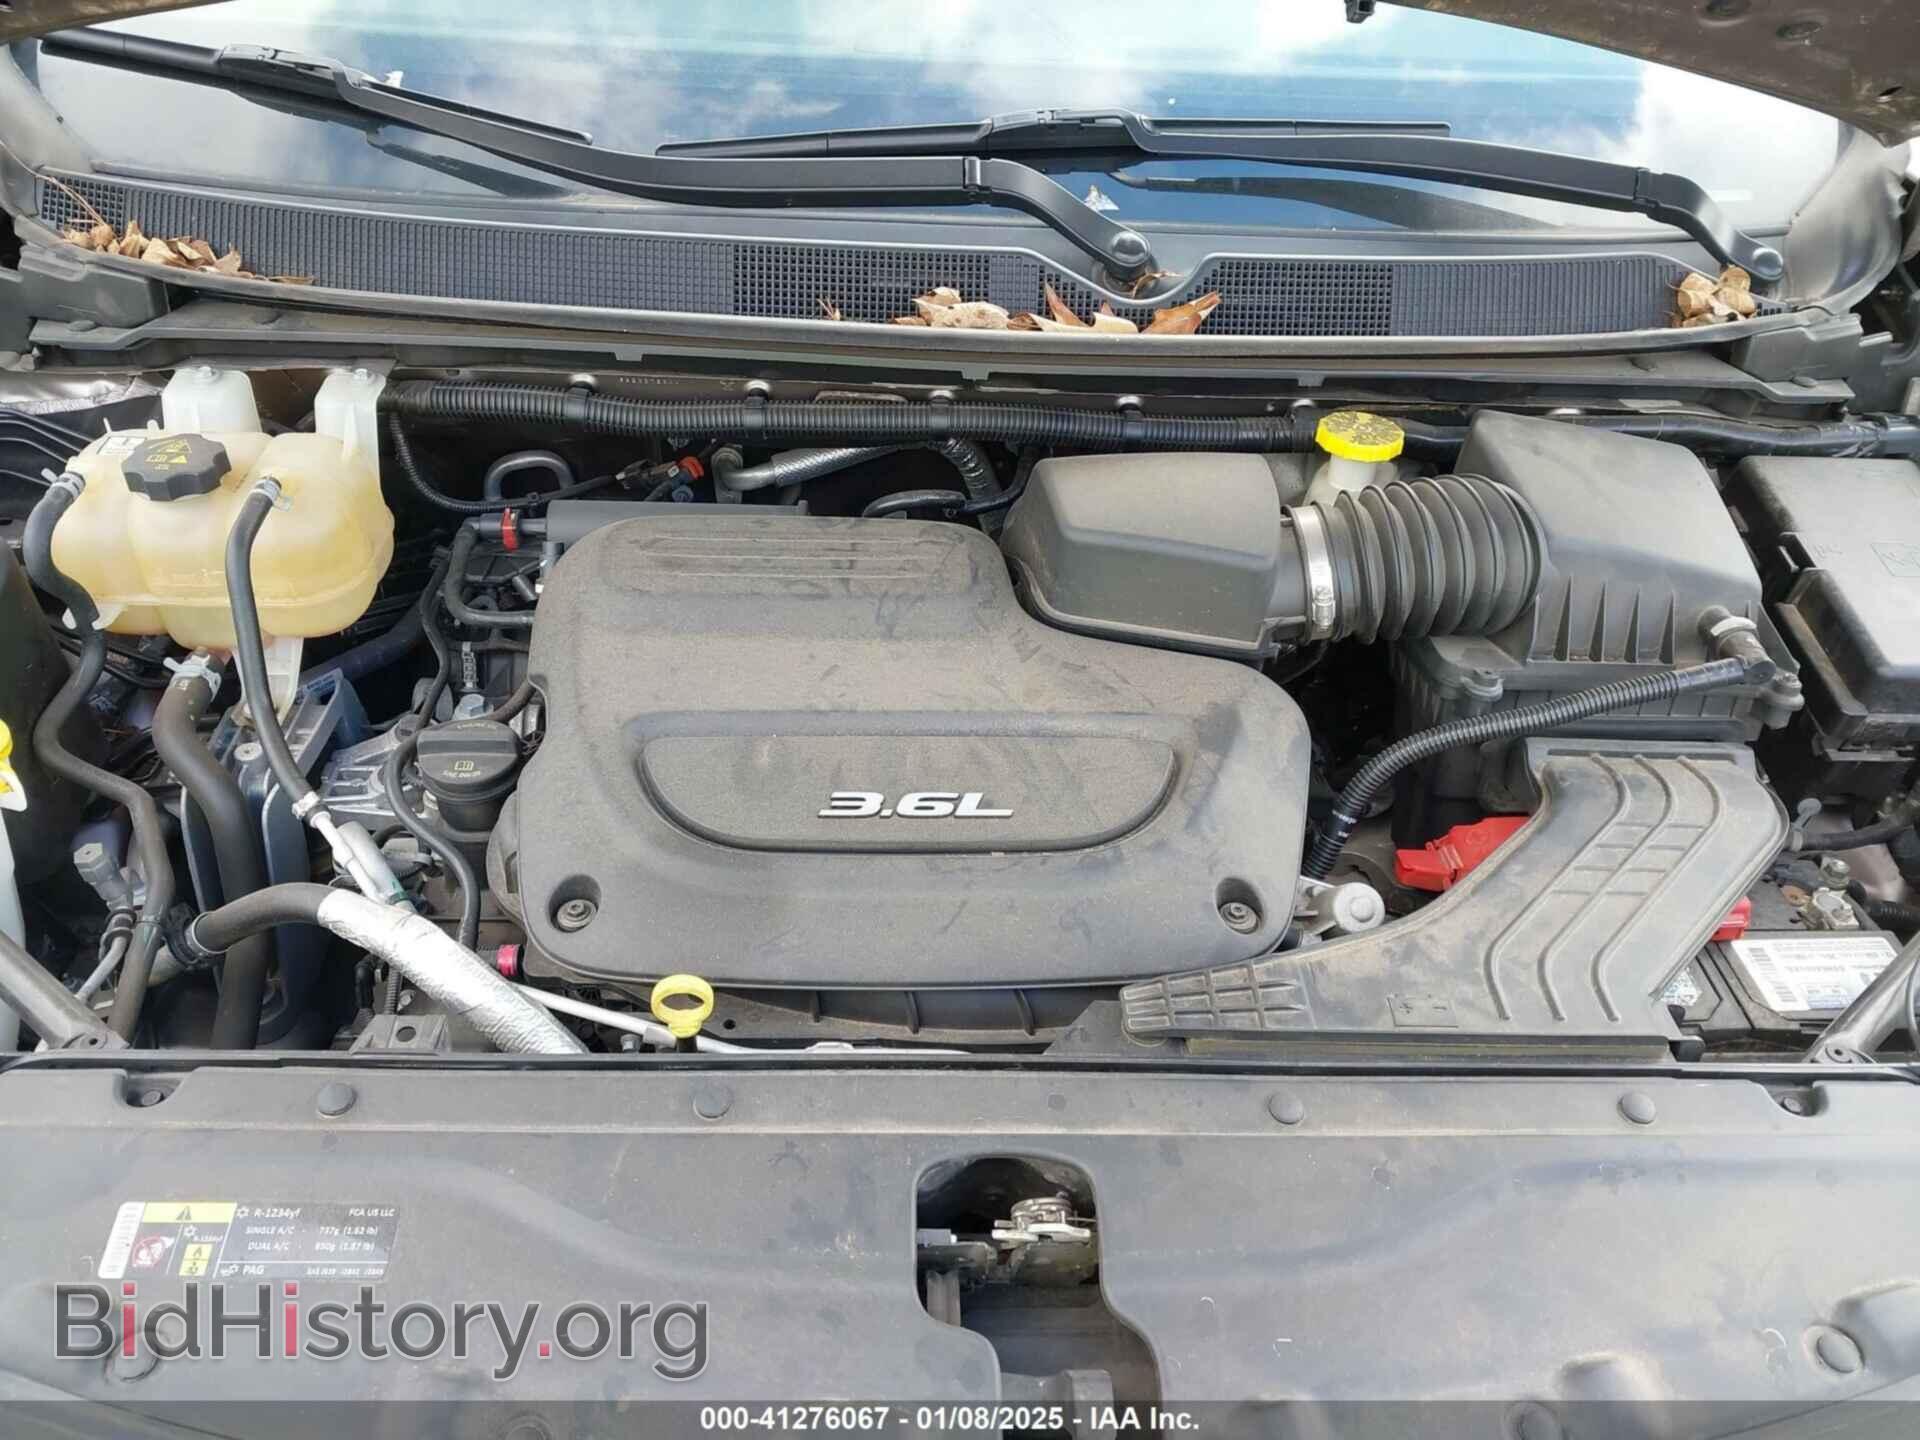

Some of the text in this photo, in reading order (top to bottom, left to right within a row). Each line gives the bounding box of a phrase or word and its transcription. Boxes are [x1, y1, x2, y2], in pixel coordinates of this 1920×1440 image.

[818, 791, 1014, 818] 3.6L
[348, 1207, 366, 1217] FCA
[380, 1207, 396, 1217] LLC
[242, 1264, 266, 1275] PAG
